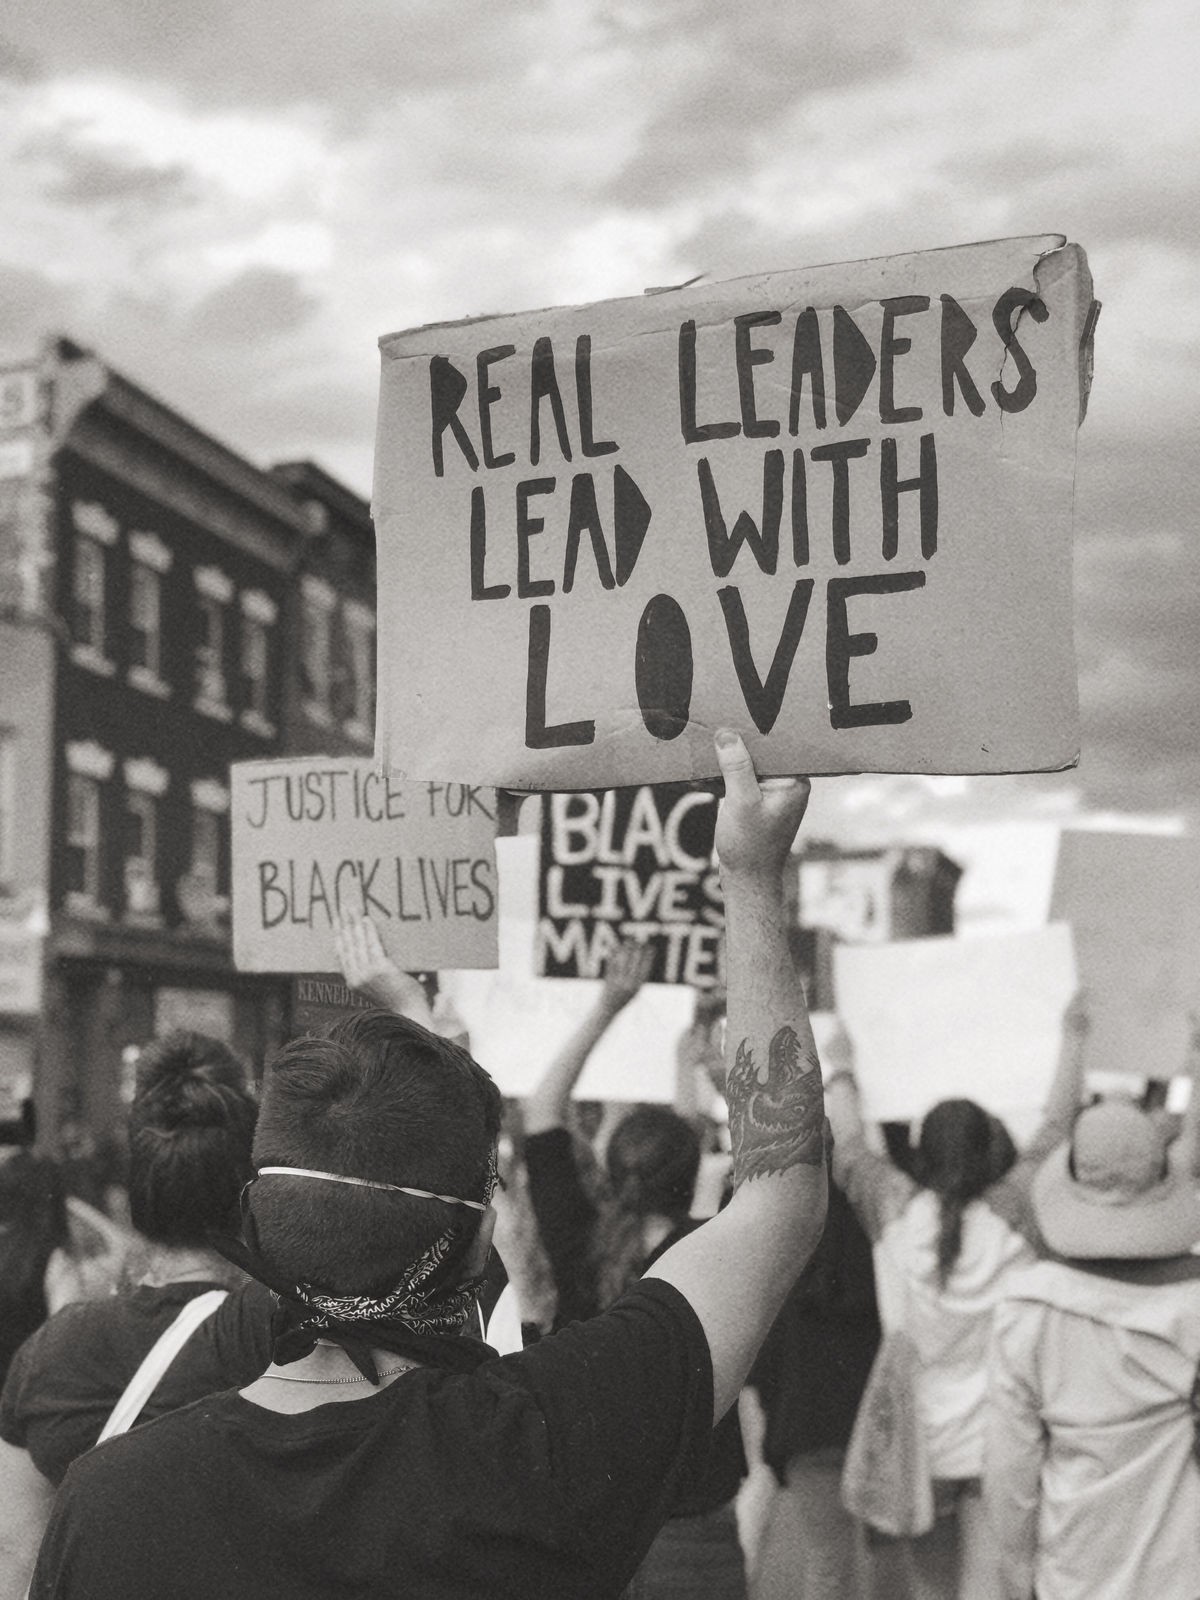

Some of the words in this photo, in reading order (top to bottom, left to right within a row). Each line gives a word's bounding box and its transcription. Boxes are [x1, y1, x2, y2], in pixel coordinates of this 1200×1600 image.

[430, 335, 620, 477] REAL
[679, 286, 1049, 444] LEADERS
[471, 464, 652, 600] LEAD
[697, 433, 938, 578] WITH
[525, 570, 926, 750] LOVE
[248, 769, 405, 829] JUSTICE
[552, 786, 720, 873] BLAC
[258, 858, 392, 930] BLACK
[396, 856, 495, 922] LIVES
[534, 917, 726, 988] MATTE
